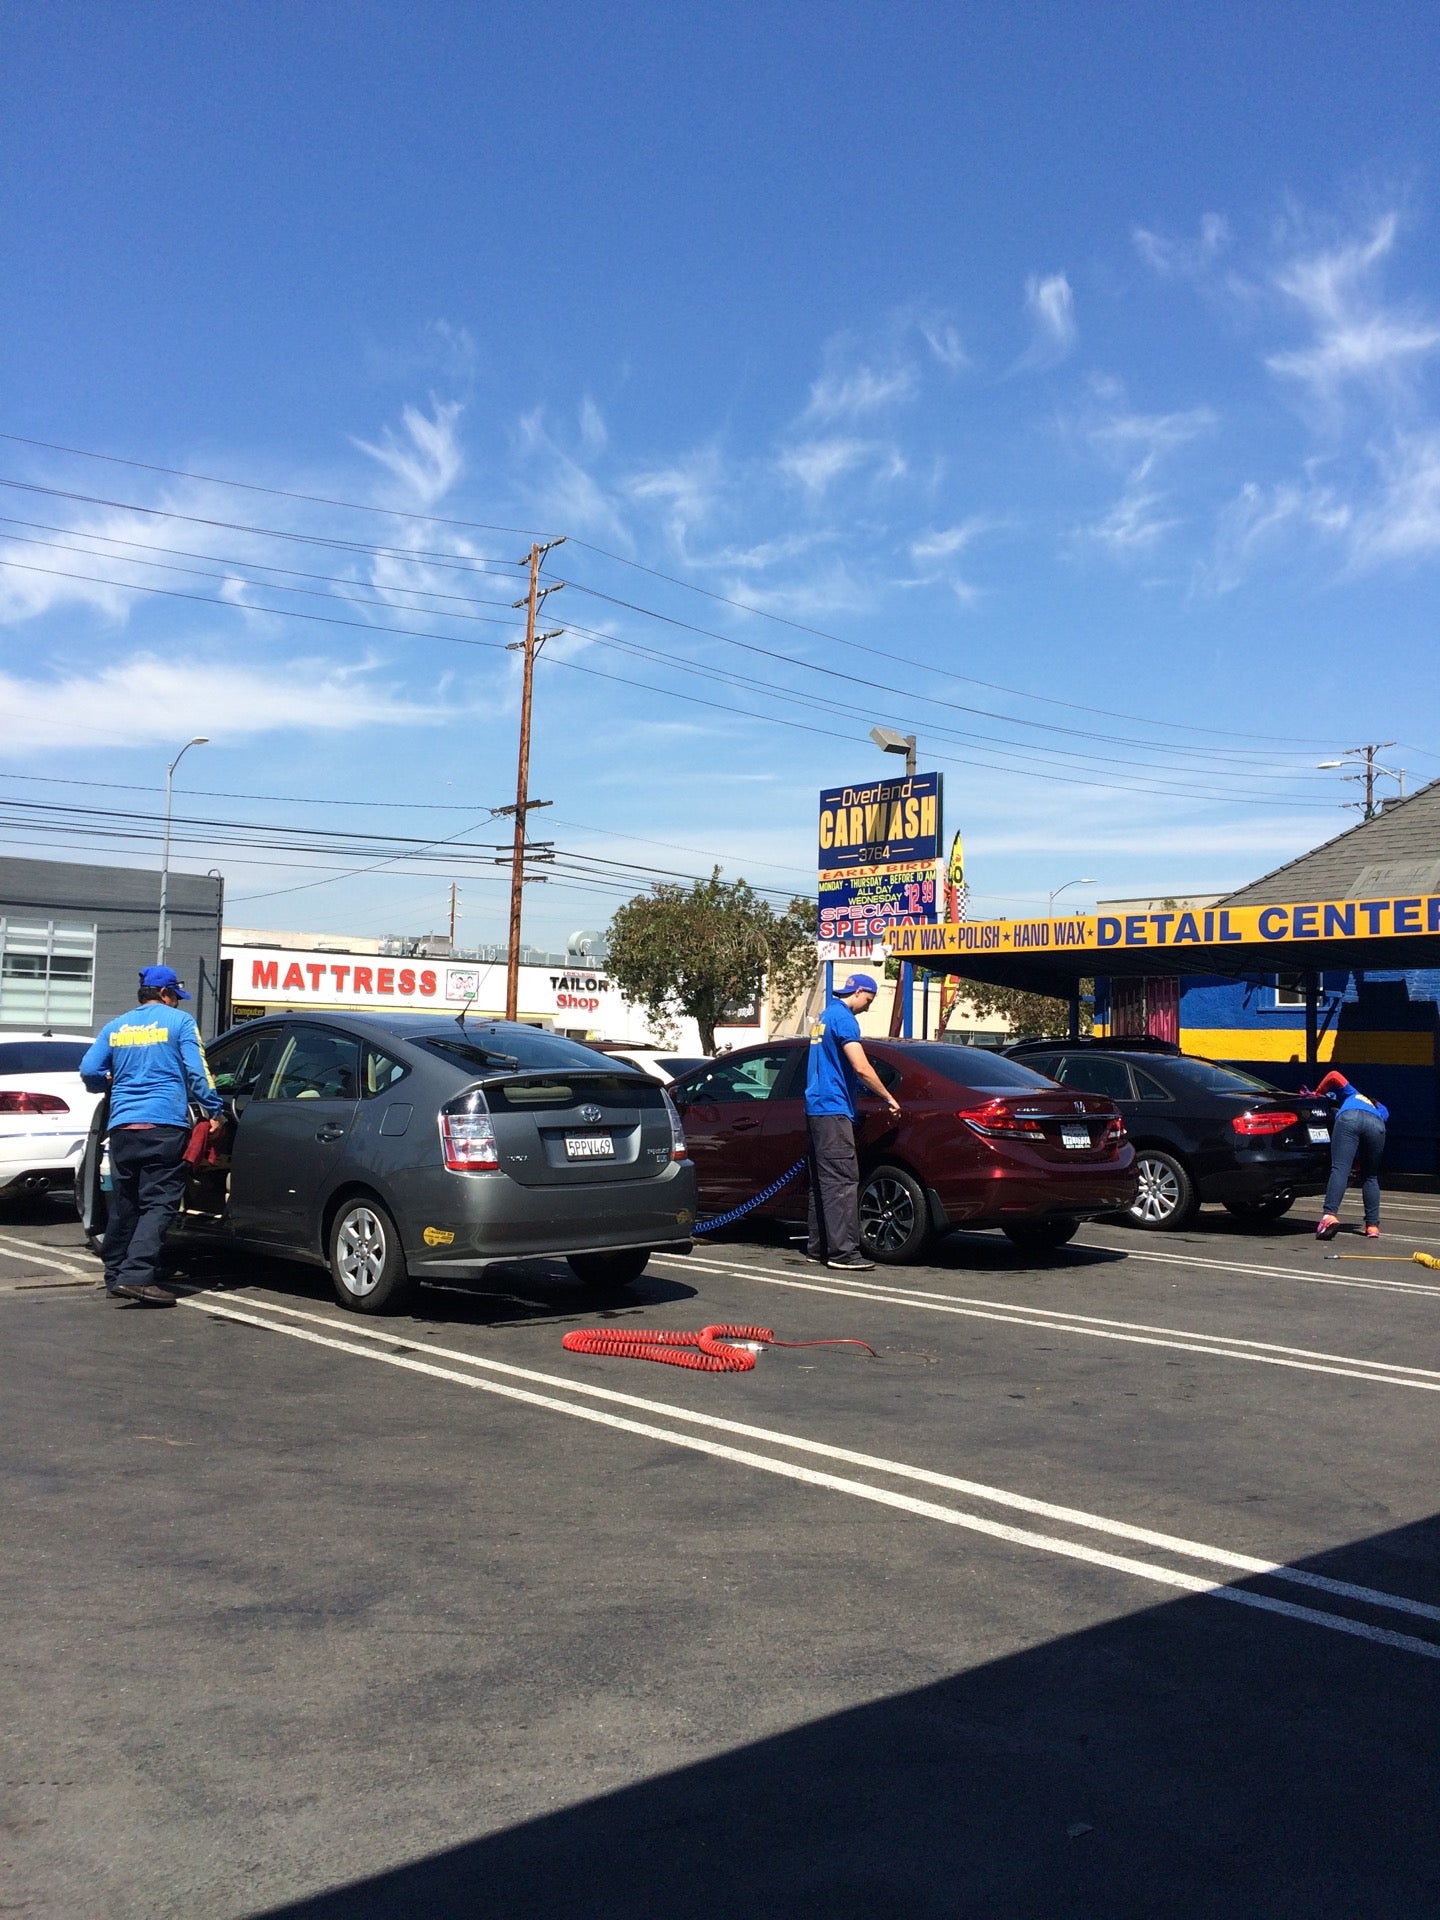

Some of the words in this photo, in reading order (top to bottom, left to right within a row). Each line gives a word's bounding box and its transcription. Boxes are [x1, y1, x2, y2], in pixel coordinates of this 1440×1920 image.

[842, 778, 913, 807] Overland
[820, 795, 936, 849] CARWASH
[859, 845, 891, 862] 3764
[823, 866, 879, 880] EARLY
[886, 862, 933, 873] BIRD
[819, 881, 843, 892] MONDAY
[850, 877, 883, 889] THURSDAY
[890, 873, 914, 884] BEFORE
[917, 872, 923, 882] 10
[925, 870, 936, 880] AM
[848, 893, 903, 905] WEDNESDAY
[857, 888, 873, 896] ALL
[876, 885, 893, 894] DAY
[821, 902, 908, 921] SPECIAL
[889, 928, 917, 951] CLAY
[920, 928, 947, 951] WAX
[958, 925, 1000, 949] POLISH
[1014, 923, 1049, 947] HAND
[1054, 921, 1086, 946] WAX
[1097, 910, 1242, 946] DETAIL
[838, 939, 874, 958] RAIN
[252, 960, 438, 997] MATTRESS
[550, 976, 609, 992] TAILOR
[234, 1006, 265, 1018] Computer
[556, 994, 599, 1012] Shop
